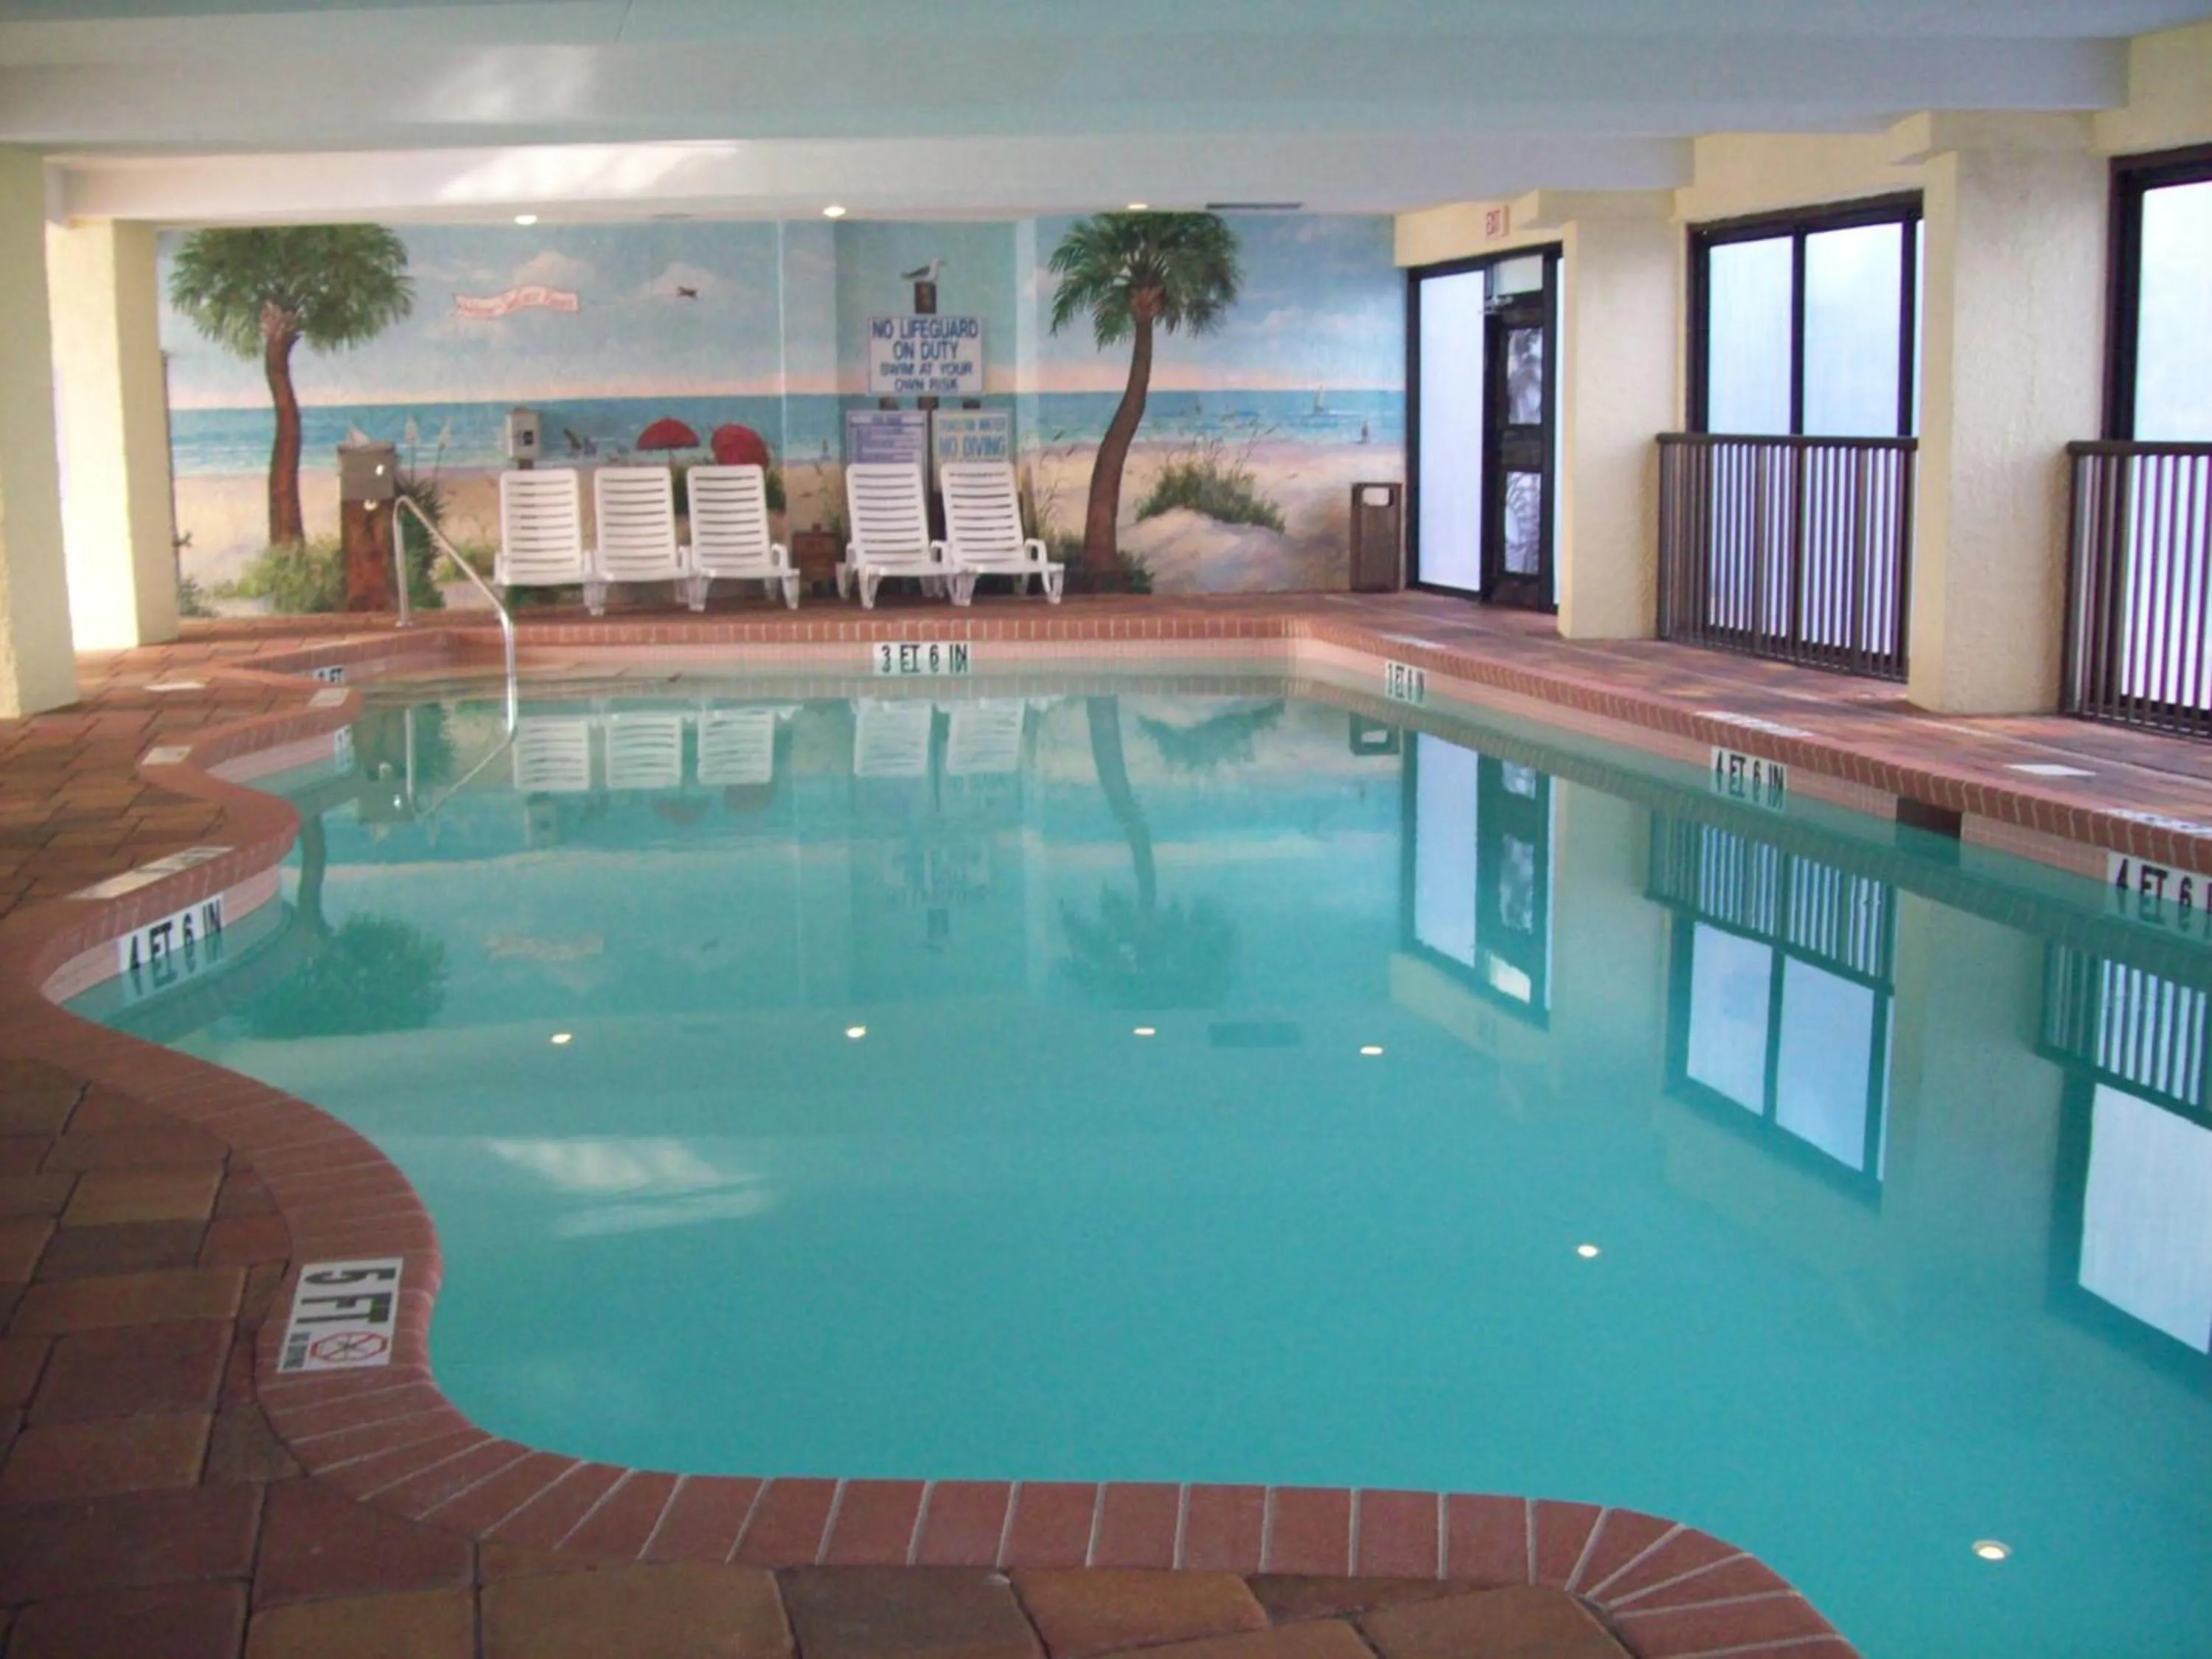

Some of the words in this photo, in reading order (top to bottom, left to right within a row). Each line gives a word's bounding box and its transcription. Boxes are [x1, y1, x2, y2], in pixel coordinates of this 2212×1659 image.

[872, 320, 893, 339] NO
[900, 319, 978, 339] LIFEGUARD
[893, 341, 914, 360] ON
[920, 340, 959, 360] DUTY
[940, 361, 973, 376] YOUR
[894, 378, 924, 392] OWN
[2117, 858, 2129, 890] 4
[2140, 864, 2168, 900] FT
[2180, 875, 2192, 908] 6
[130, 934, 140, 970] 4
[149, 921, 173, 963] FT
[183, 913, 194, 945] 6
[203, 899, 222, 935] IN
